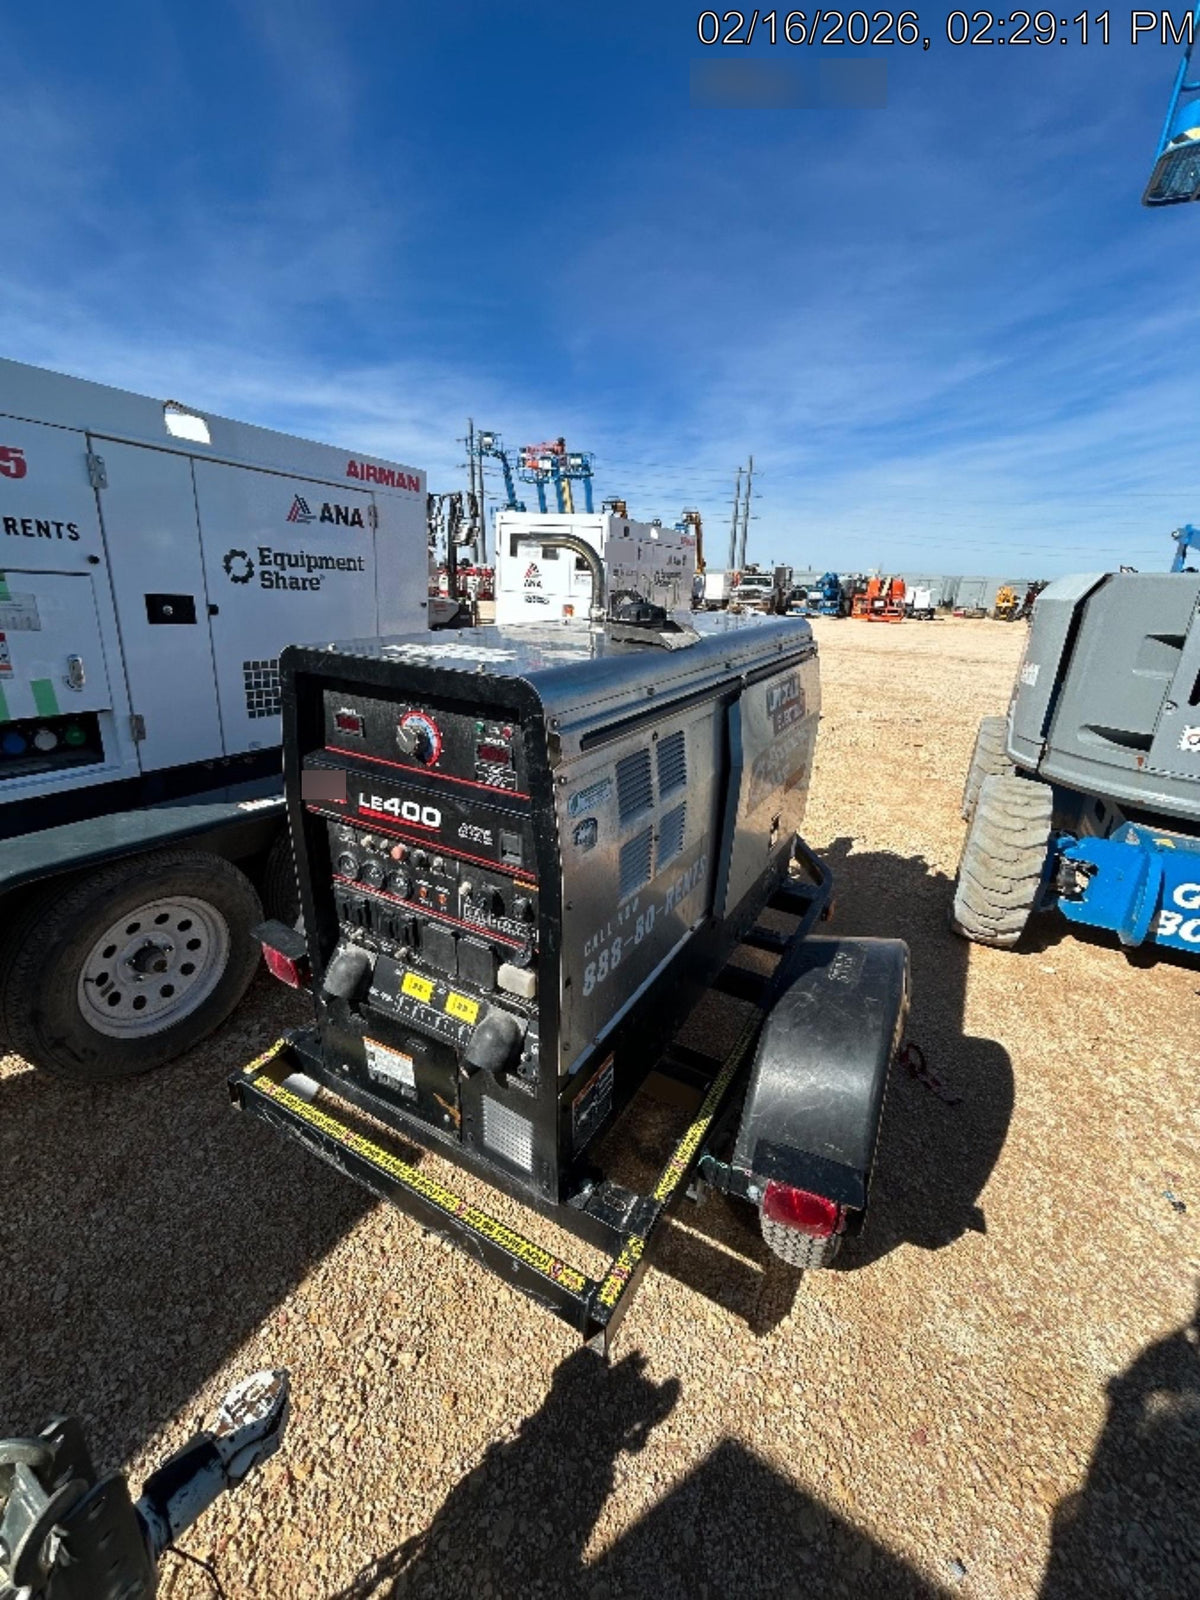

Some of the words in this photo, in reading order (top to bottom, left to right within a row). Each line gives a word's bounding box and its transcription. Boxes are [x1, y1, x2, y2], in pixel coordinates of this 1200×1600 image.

[346, 460, 420, 493] AIRMAN
[320, 503, 364, 528] ANA
[3, 517, 80, 541] RENTS
[257, 547, 365, 573] Equipment
[358, 793, 441, 827] LE400
